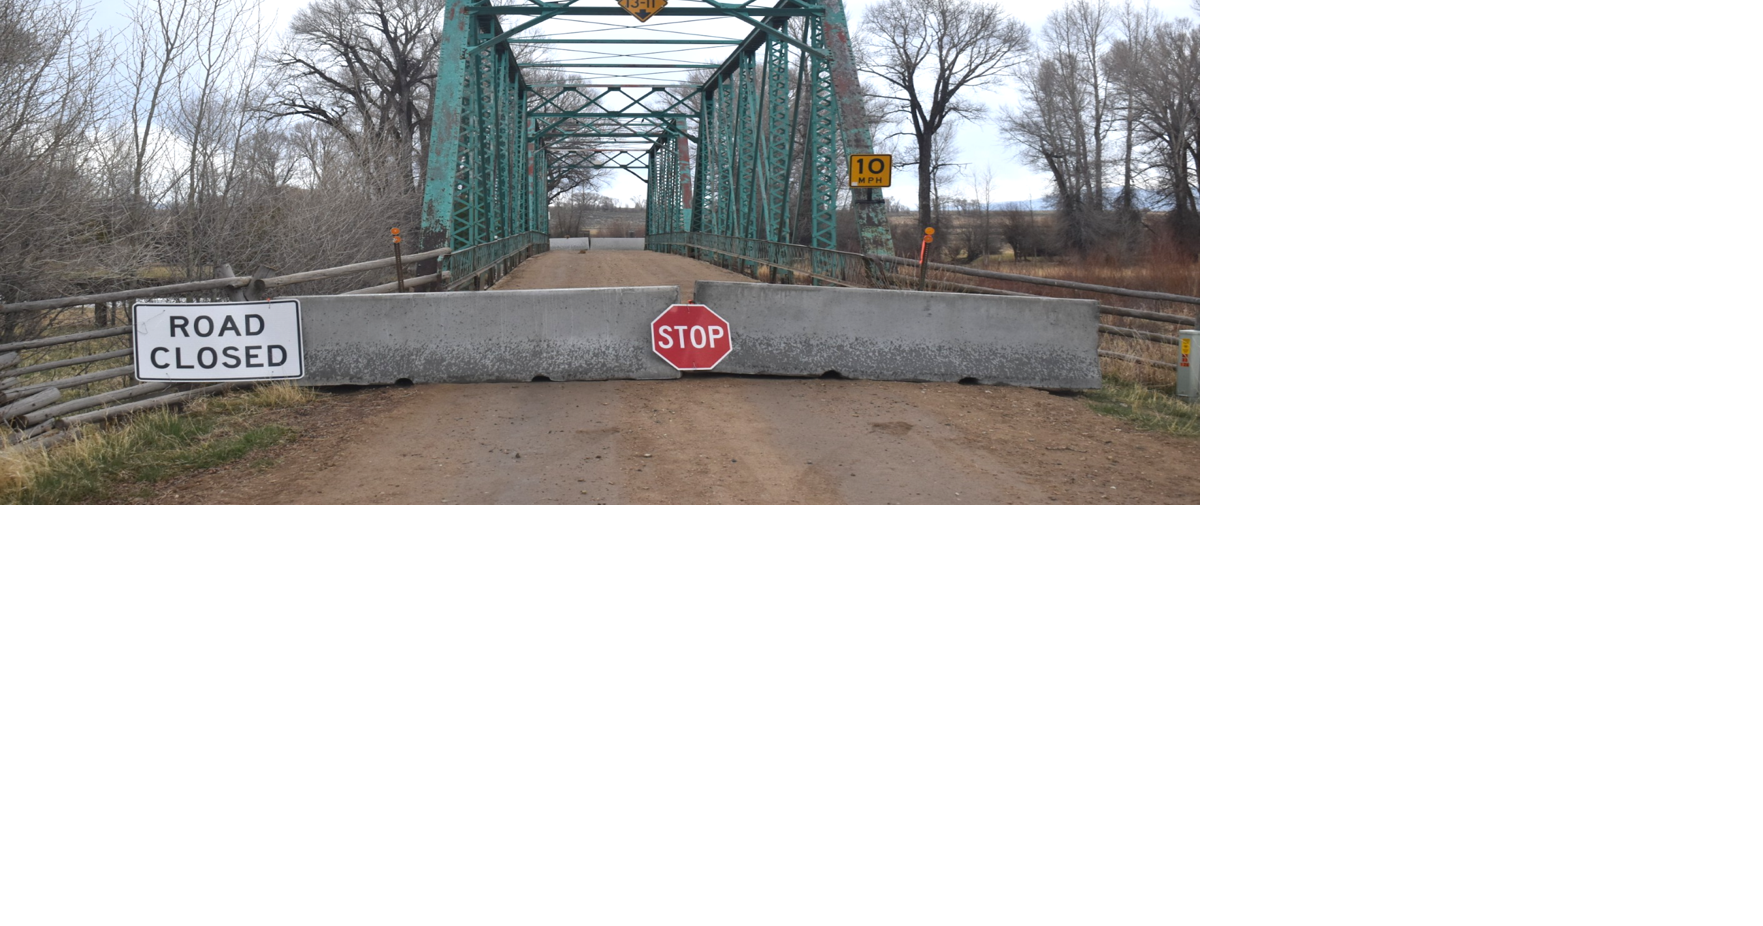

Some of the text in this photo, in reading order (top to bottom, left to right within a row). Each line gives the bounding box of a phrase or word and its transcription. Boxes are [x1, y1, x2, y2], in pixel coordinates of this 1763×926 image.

[857, 158, 885, 175] 10
[169, 313, 265, 338] ROAD
[658, 325, 724, 349] STOP
[150, 344, 288, 369] CLOSED
